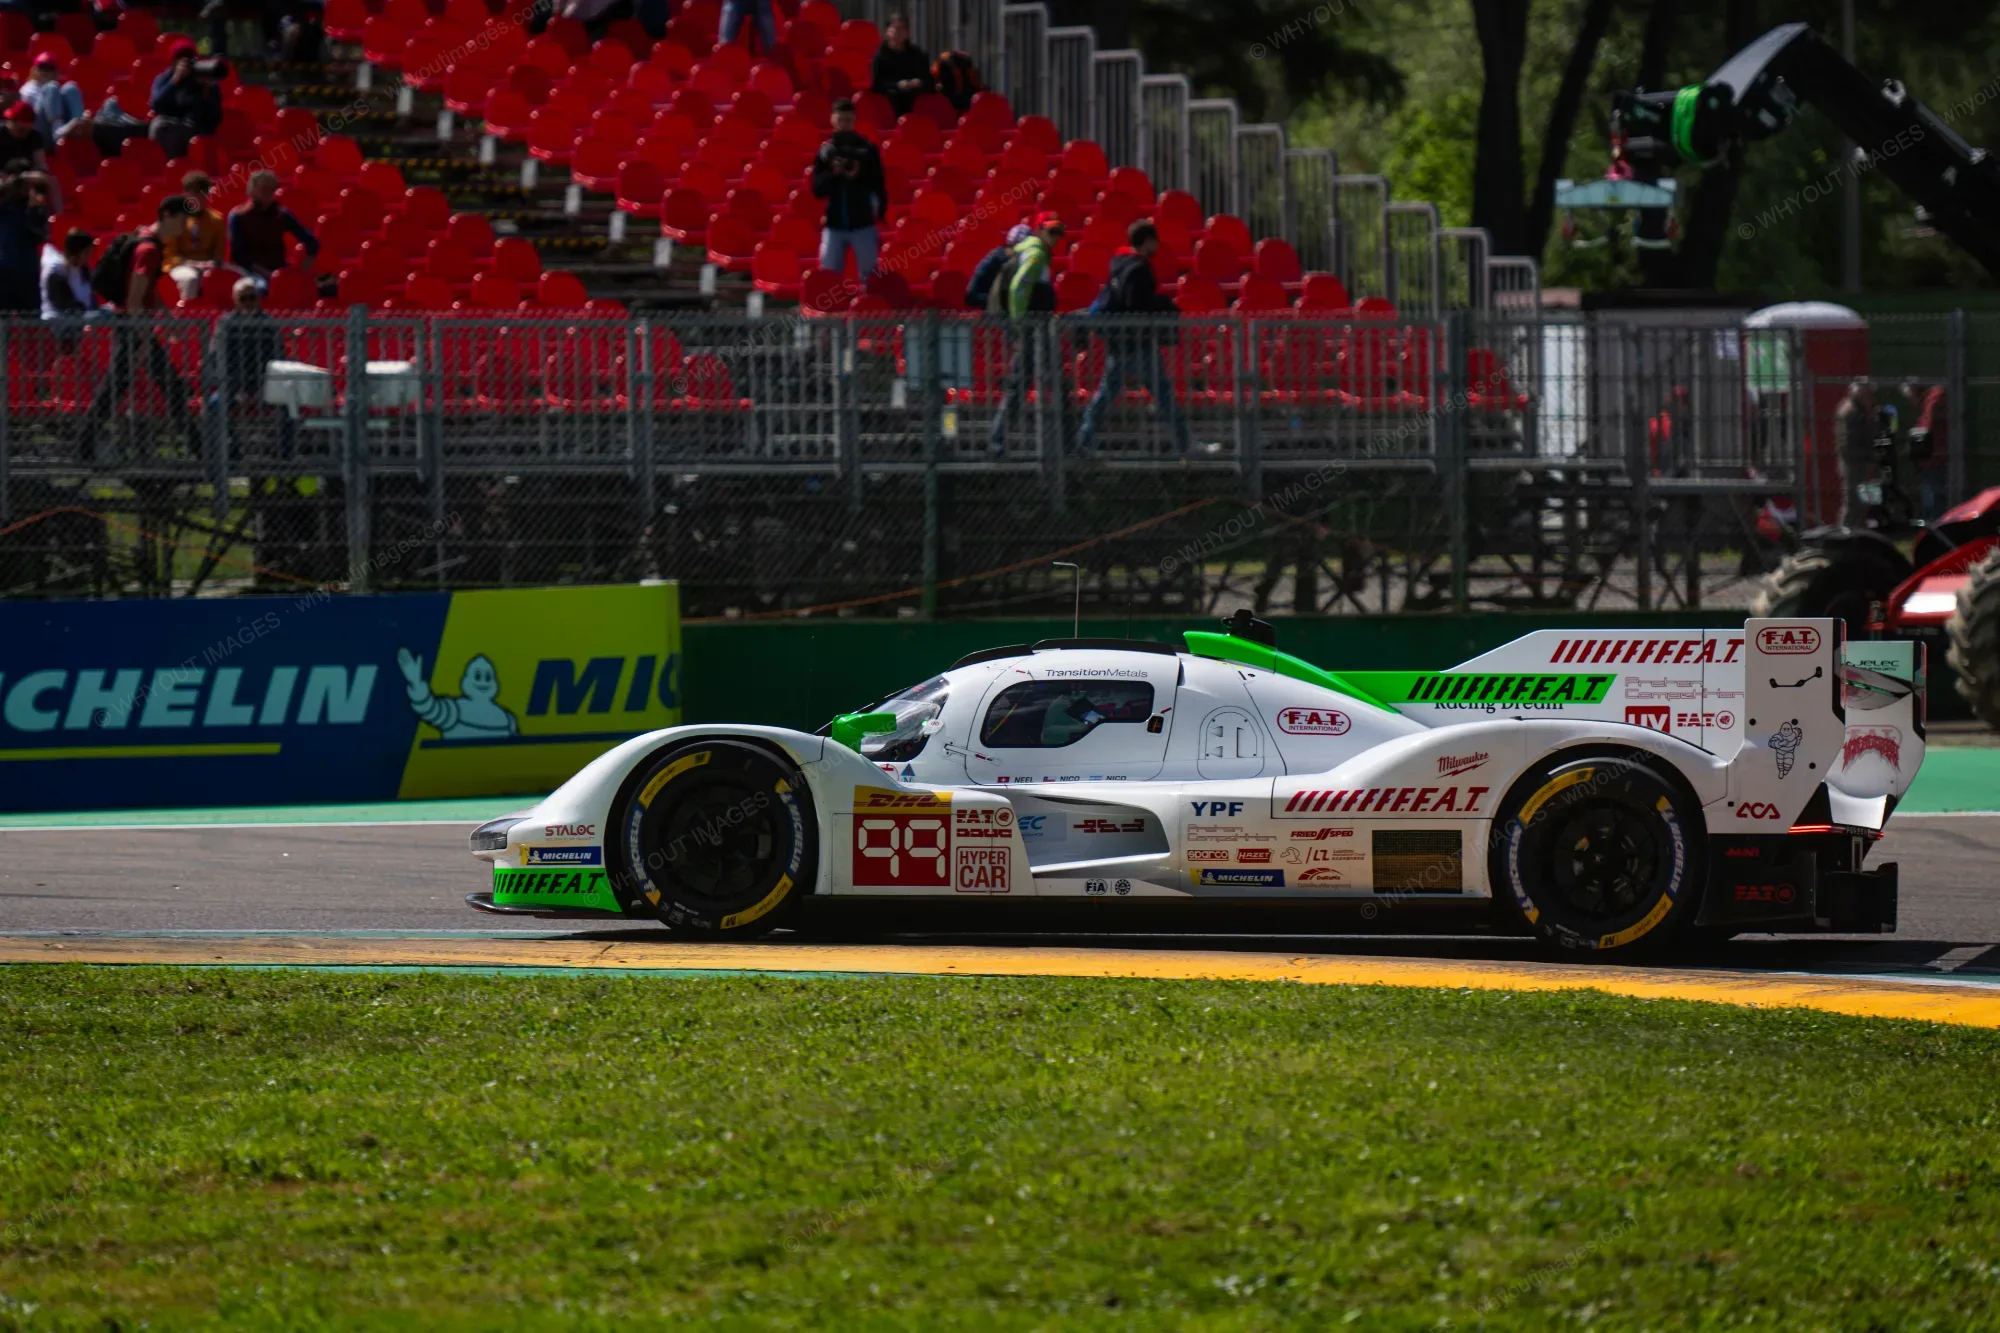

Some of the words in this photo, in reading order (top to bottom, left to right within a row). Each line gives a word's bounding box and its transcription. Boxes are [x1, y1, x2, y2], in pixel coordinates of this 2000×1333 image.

[1045, 667, 1148, 679] TransitionMetals
[0, 664, 379, 732] CHELIN
[1288, 724, 1342, 733] INTERNATIONAL
[1436, 752, 1490, 774] Milwaukee
[867, 793, 937, 808] DHL
[1190, 801, 1244, 817] YPF
[544, 824, 596, 837] STALOC
[857, 819, 947, 878] 99
[1188, 850, 1228, 861] sparco
[1239, 851, 1270, 860] HAZET
[542, 852, 592, 860] MICHELIN
[959, 850, 1006, 865] HYPER
[959, 865, 1006, 889] CAR
[1217, 874, 1274, 882] MICHELIN
